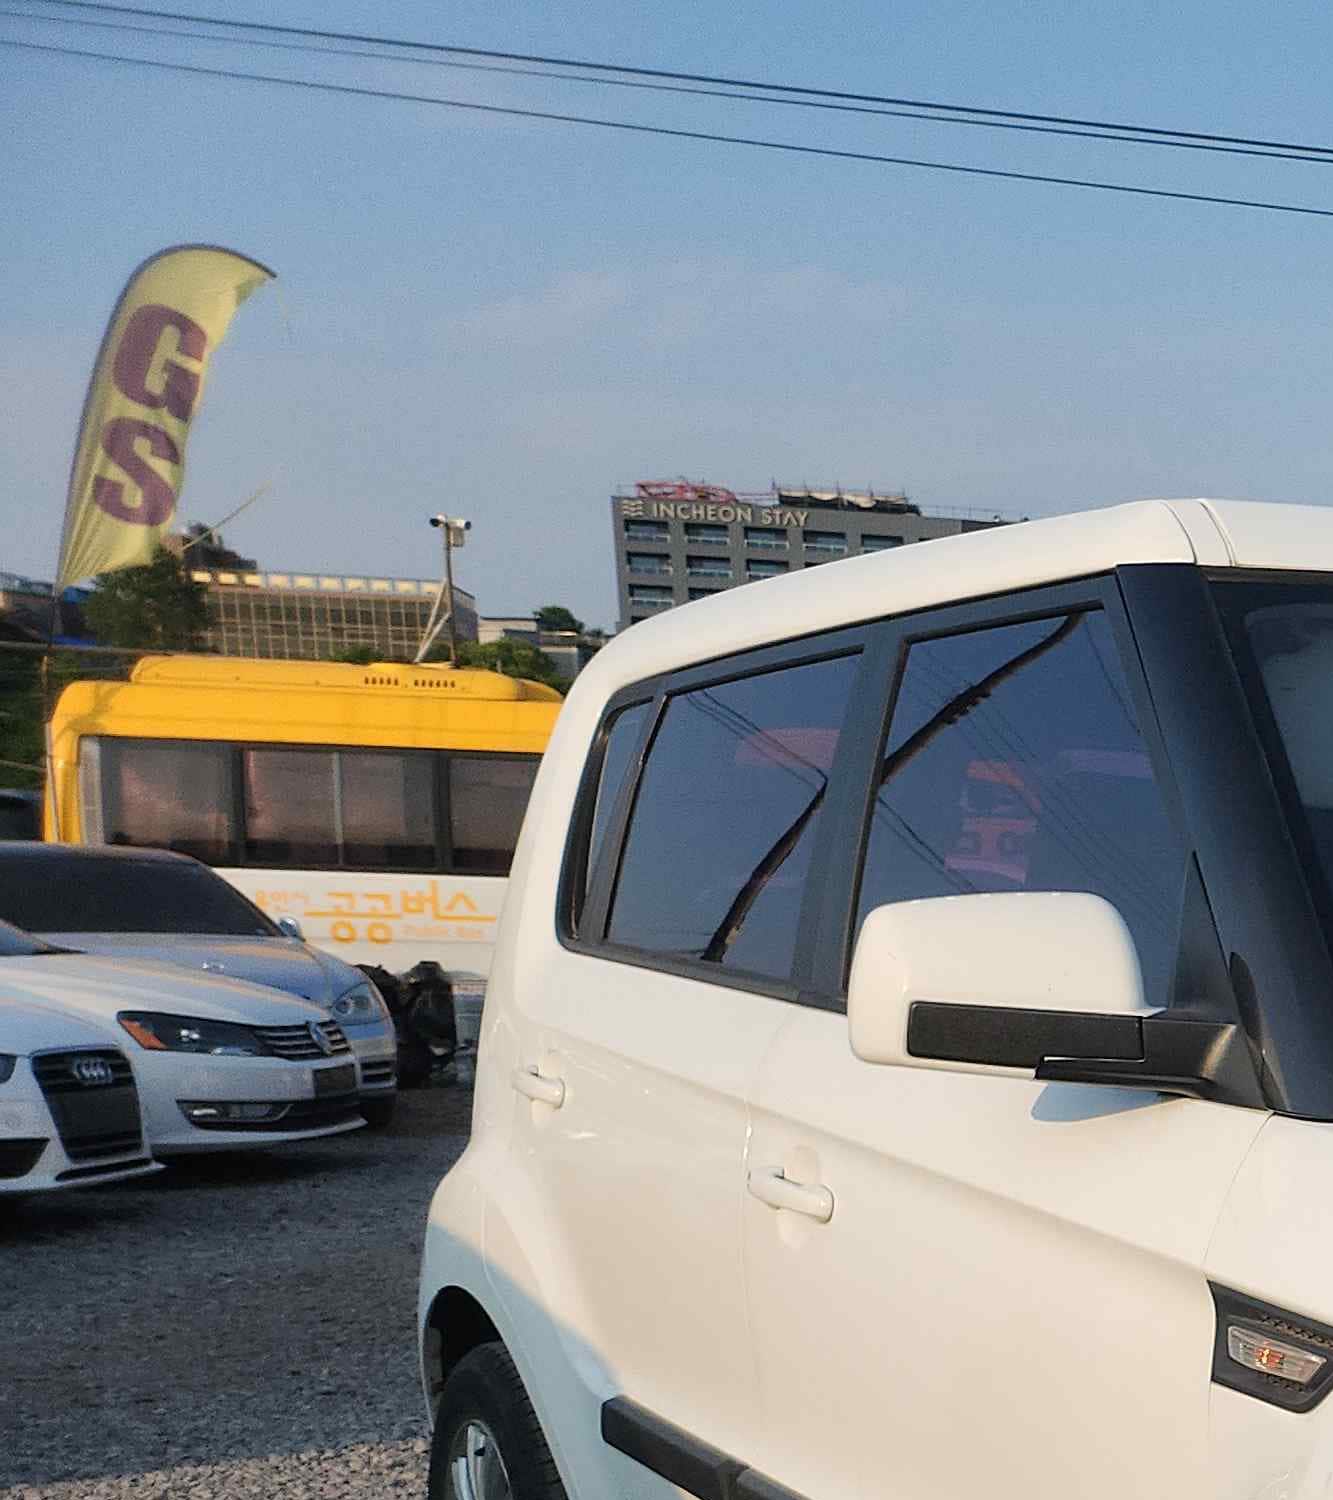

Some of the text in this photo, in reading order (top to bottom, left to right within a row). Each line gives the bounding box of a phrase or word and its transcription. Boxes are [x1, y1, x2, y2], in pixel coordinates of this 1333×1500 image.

[93, 303, 208, 528] GS
[653, 502, 809, 527] INCHEON STAY
[303, 879, 497, 944] 공공버스
